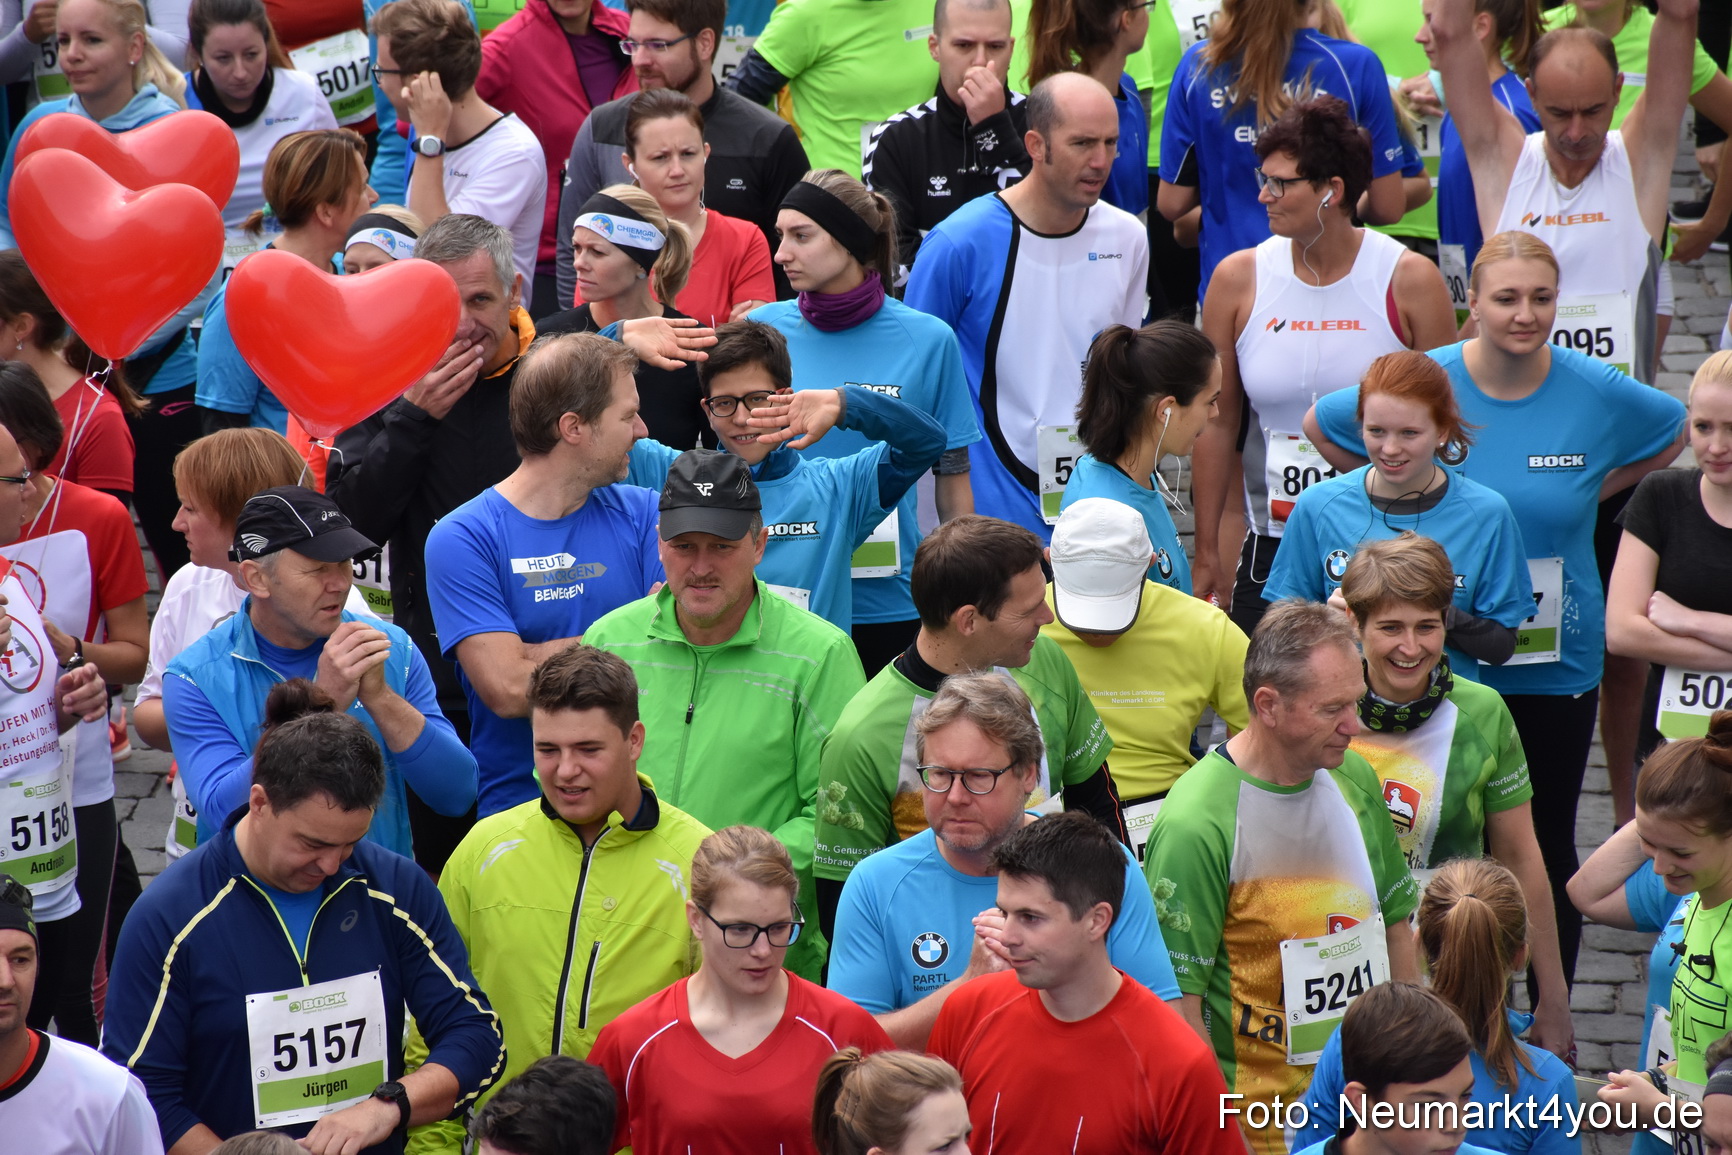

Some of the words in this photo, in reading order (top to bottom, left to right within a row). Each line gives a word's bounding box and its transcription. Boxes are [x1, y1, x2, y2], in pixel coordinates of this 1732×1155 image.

[316, 56, 371, 97] 5017
[927, 188, 952, 197] hummel
[1544, 211, 1611, 226] KLEBL
[616, 224, 656, 238] CHIEMGAU
[1557, 303, 1597, 317] BOCK
[1290, 320, 1368, 331] KLEBL
[1526, 453, 1587, 469] BOCK
[543, 565, 596, 584] MORGEN
[534, 582, 584, 603] BEWEGEN
[30, 703, 46, 719] MIT
[11, 801, 69, 852] 5158
[833, 845, 868, 856] Genuss
[30, 855, 65, 875] Andreas
[914, 933, 946, 946] BMW
[1331, 936, 1362, 957] BOCK
[912, 973, 951, 985] PARTL
[1305, 959, 1374, 1015] 5241
[302, 992, 347, 1011] BOCK
[273, 1017, 367, 1073] 5157
[259, 1069, 266, 1079] S
[302, 1078, 349, 1099] Jürgen
